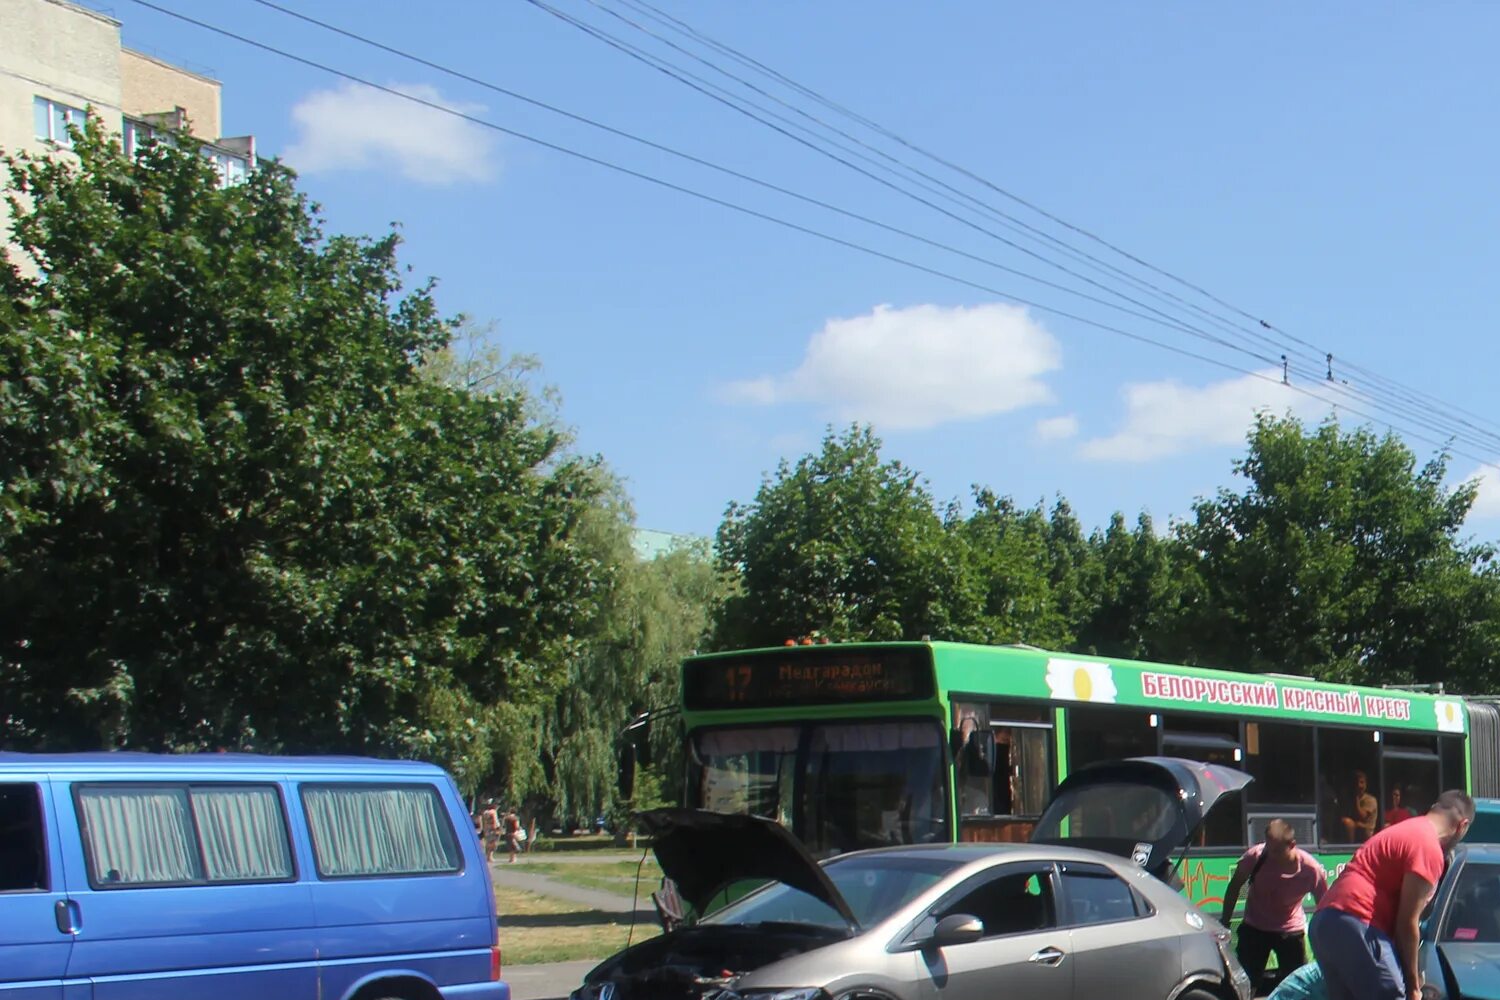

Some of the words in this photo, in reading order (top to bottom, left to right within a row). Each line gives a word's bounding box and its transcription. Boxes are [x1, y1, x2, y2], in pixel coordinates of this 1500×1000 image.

[726, 666, 752, 687] 17
[1142, 673, 1278, 708] БЕЛОРУССКИЙ
[1284, 688, 1361, 714] КРАСНЫЙ
[1367, 699, 1410, 719] КРЕСТ
